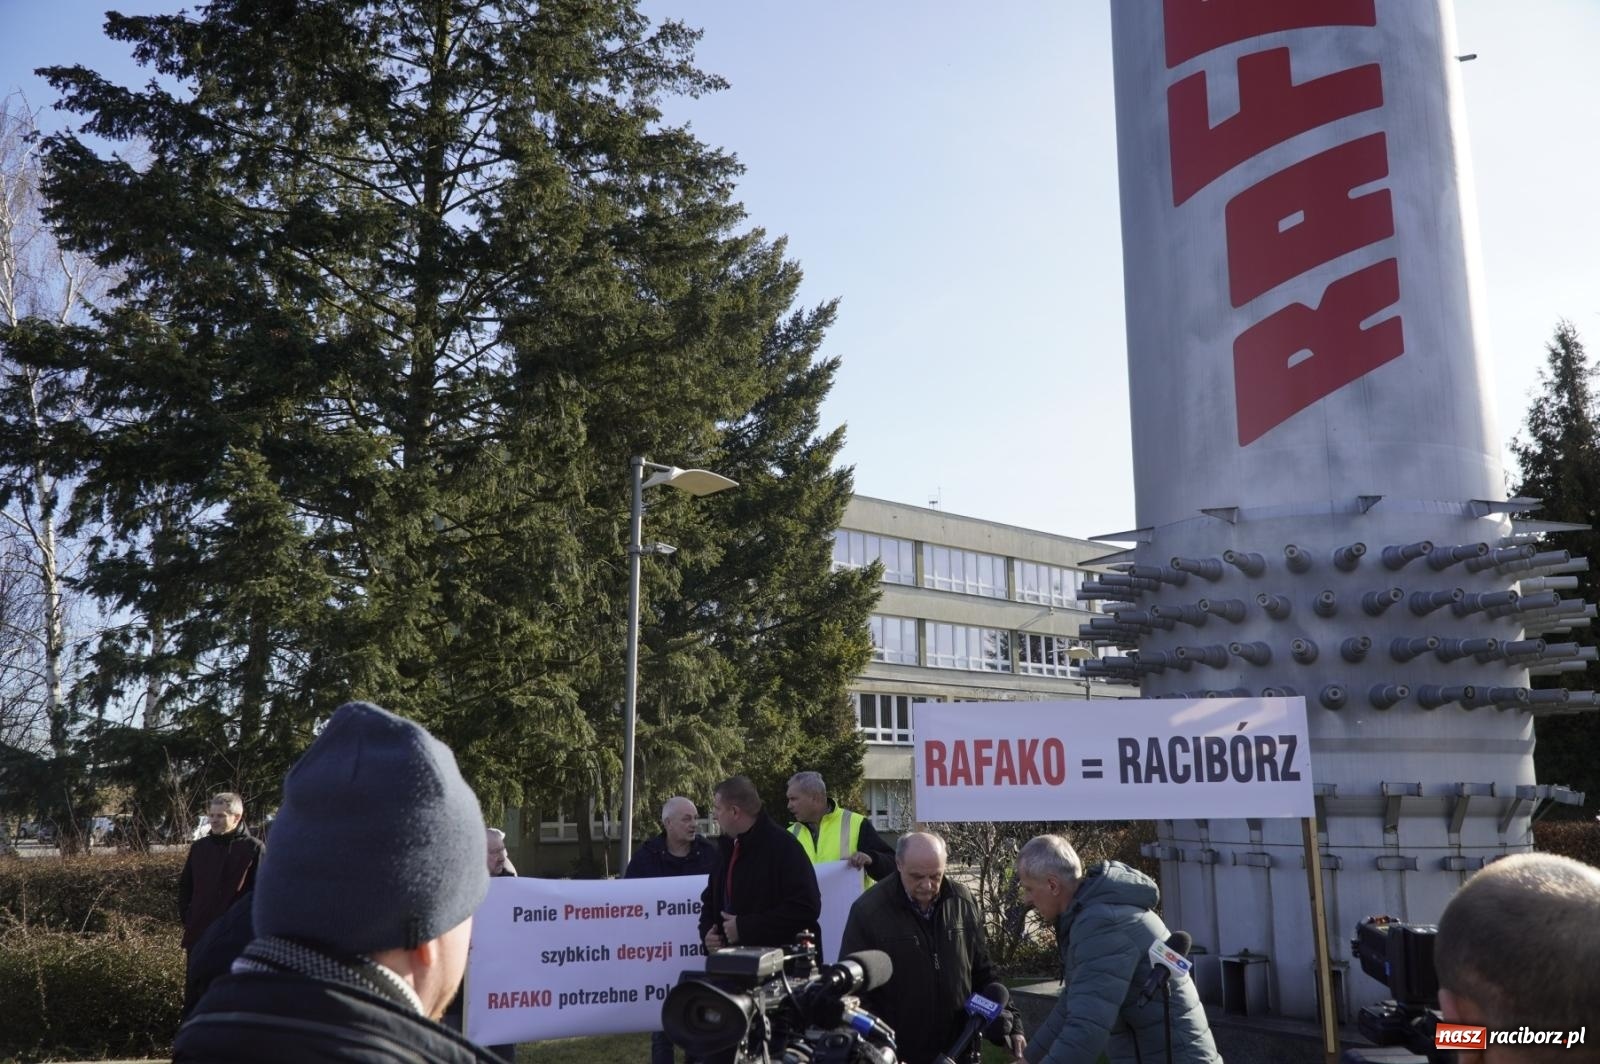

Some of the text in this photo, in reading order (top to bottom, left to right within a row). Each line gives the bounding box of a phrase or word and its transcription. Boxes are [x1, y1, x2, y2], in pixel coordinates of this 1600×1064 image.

[924, 721, 1301, 787] RAFAKO = RACIBÓRZ
[512, 898, 701, 922] Panie Premierze, Panie
[540, 944, 610, 967] szybkich
[616, 941, 673, 963] decyzji
[487, 989, 553, 1010] RAFAKO
[558, 986, 639, 1008] potrzebne
